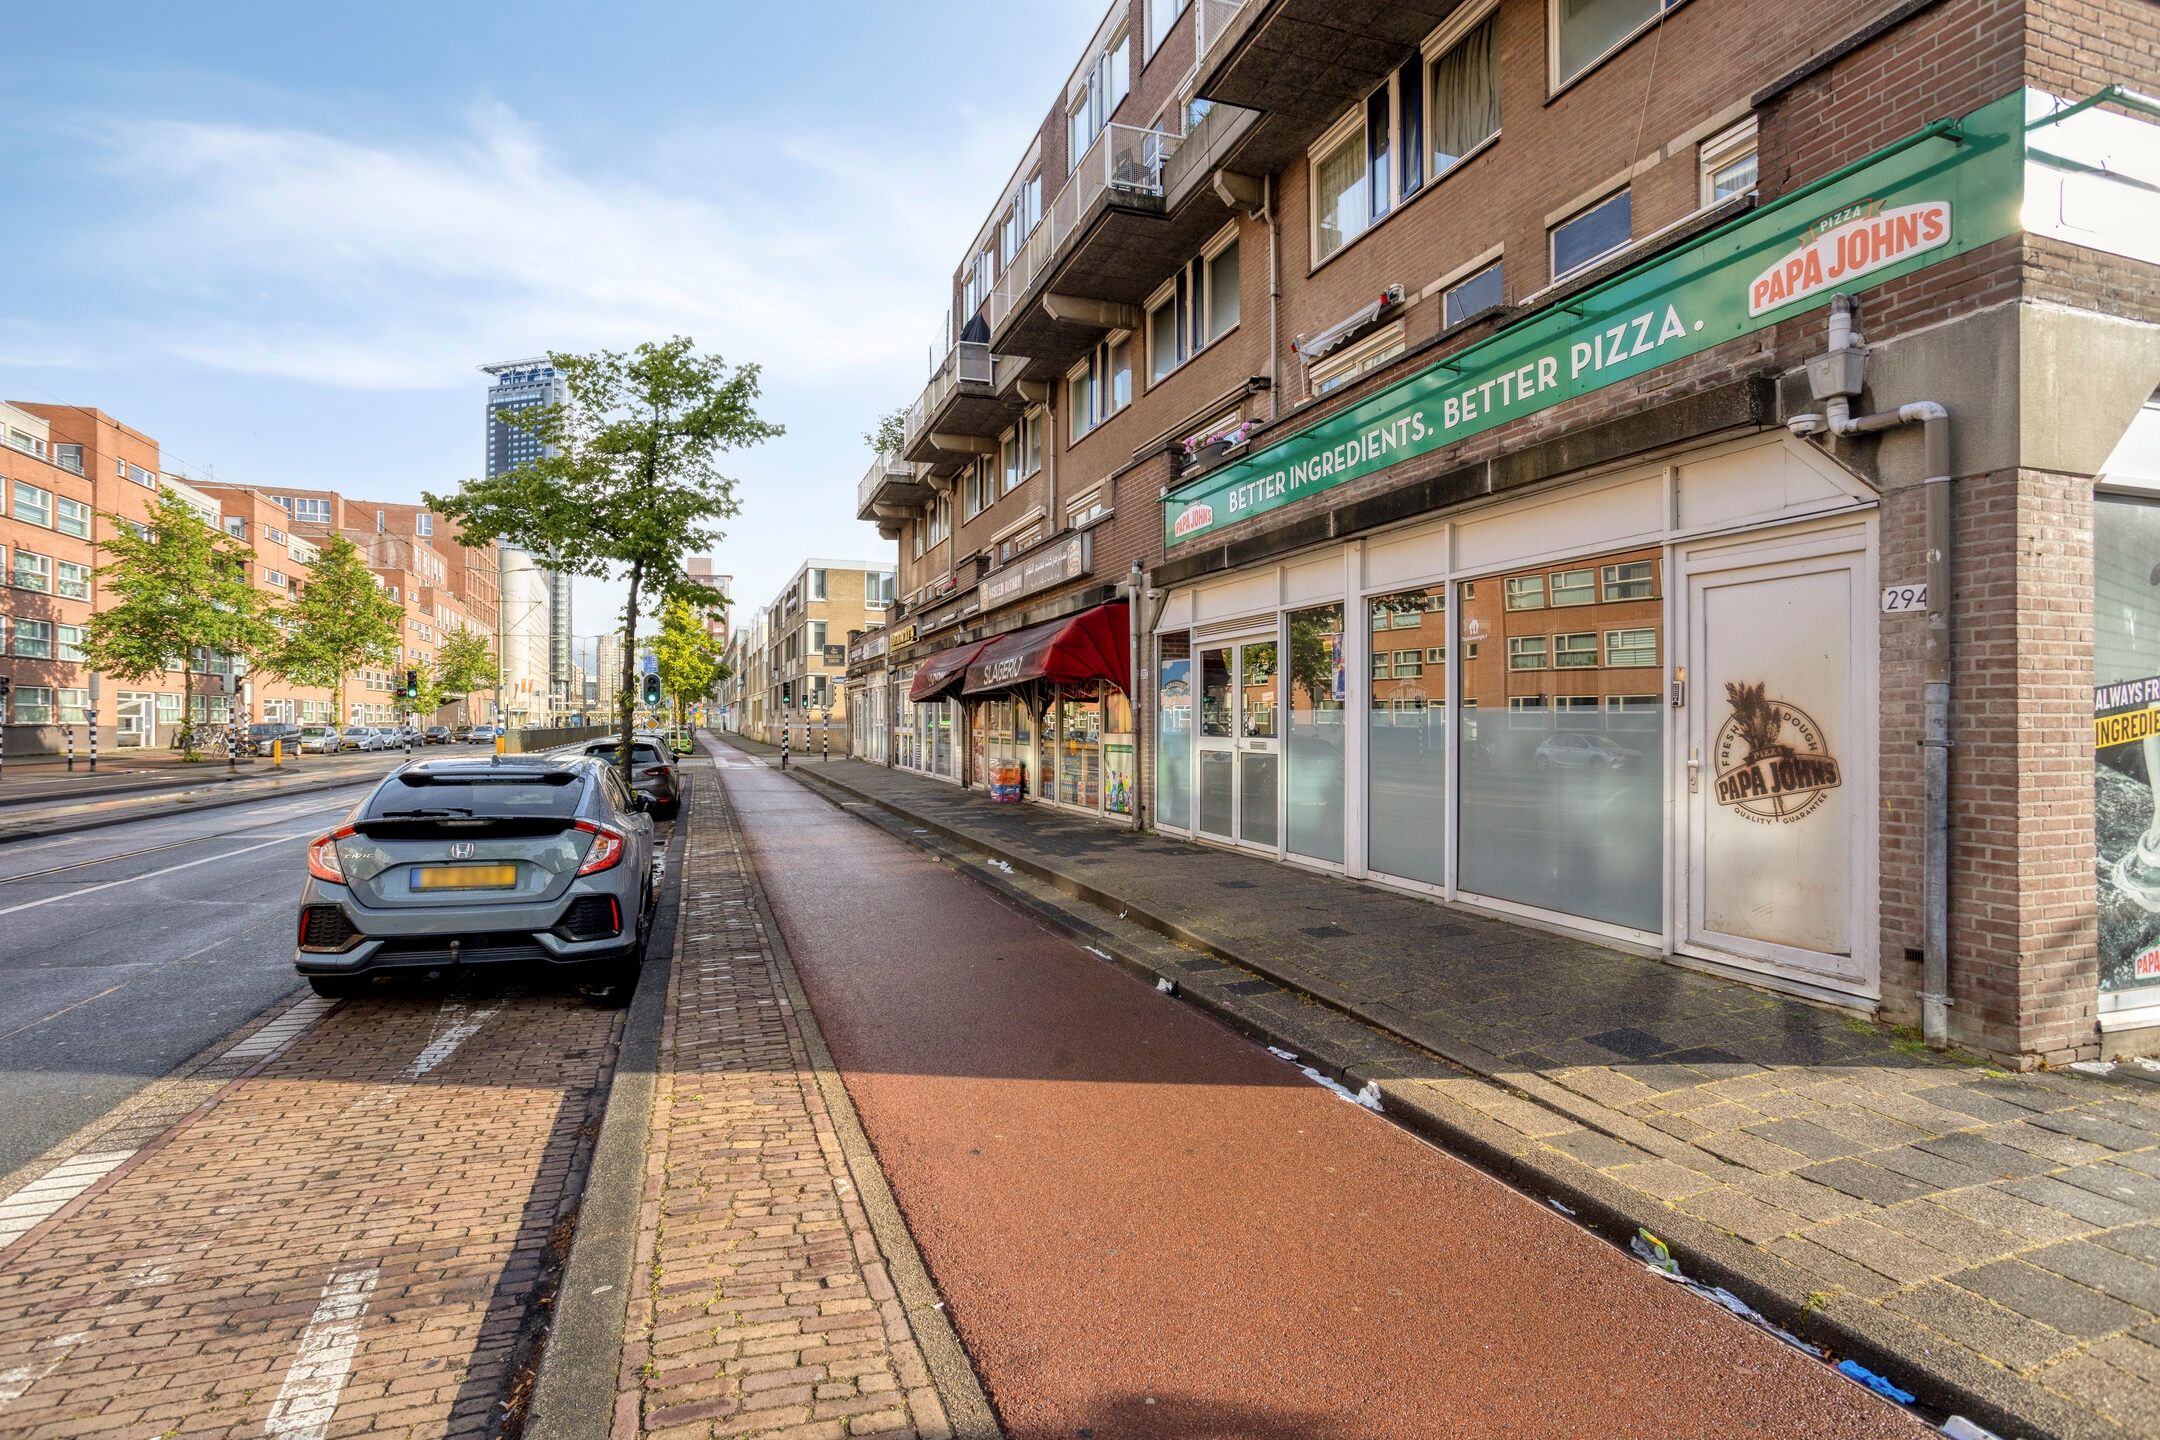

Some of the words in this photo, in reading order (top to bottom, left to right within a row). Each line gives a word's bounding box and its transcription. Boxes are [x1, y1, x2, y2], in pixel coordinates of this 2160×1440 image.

[1820, 206, 1861, 232] PIZZA
[1753, 249, 1824, 309] PAPA
[1827, 208, 1944, 279] JOHN'S
[1229, 470, 1286, 513] BETTER
[1289, 412, 1434, 490] INGREDIENTS.
[1443, 356, 1558, 430] BETTER
[1571, 303, 1705, 380] PIZZA.
[1176, 512, 1191, 535] PAPA
[1887, 586, 1927, 609] 294
[983, 656, 1024, 686] SLAGERIJ
[2095, 681, 2143, 711] ALWAYS
[2144, 678, 2160, 701] FR
[1783, 712, 1818, 751] DOUGH
[2095, 709, 2160, 746] INGREDIE
[1721, 724, 1740, 767] FRESH
[1718, 765, 1768, 802] PAPA
[1733, 807, 1772, 825] QUALITY
[1782, 792, 1828, 825] GUARANTEE
[344, 852, 376, 860] CIVIC
[2136, 950, 2160, 975] PAPA
